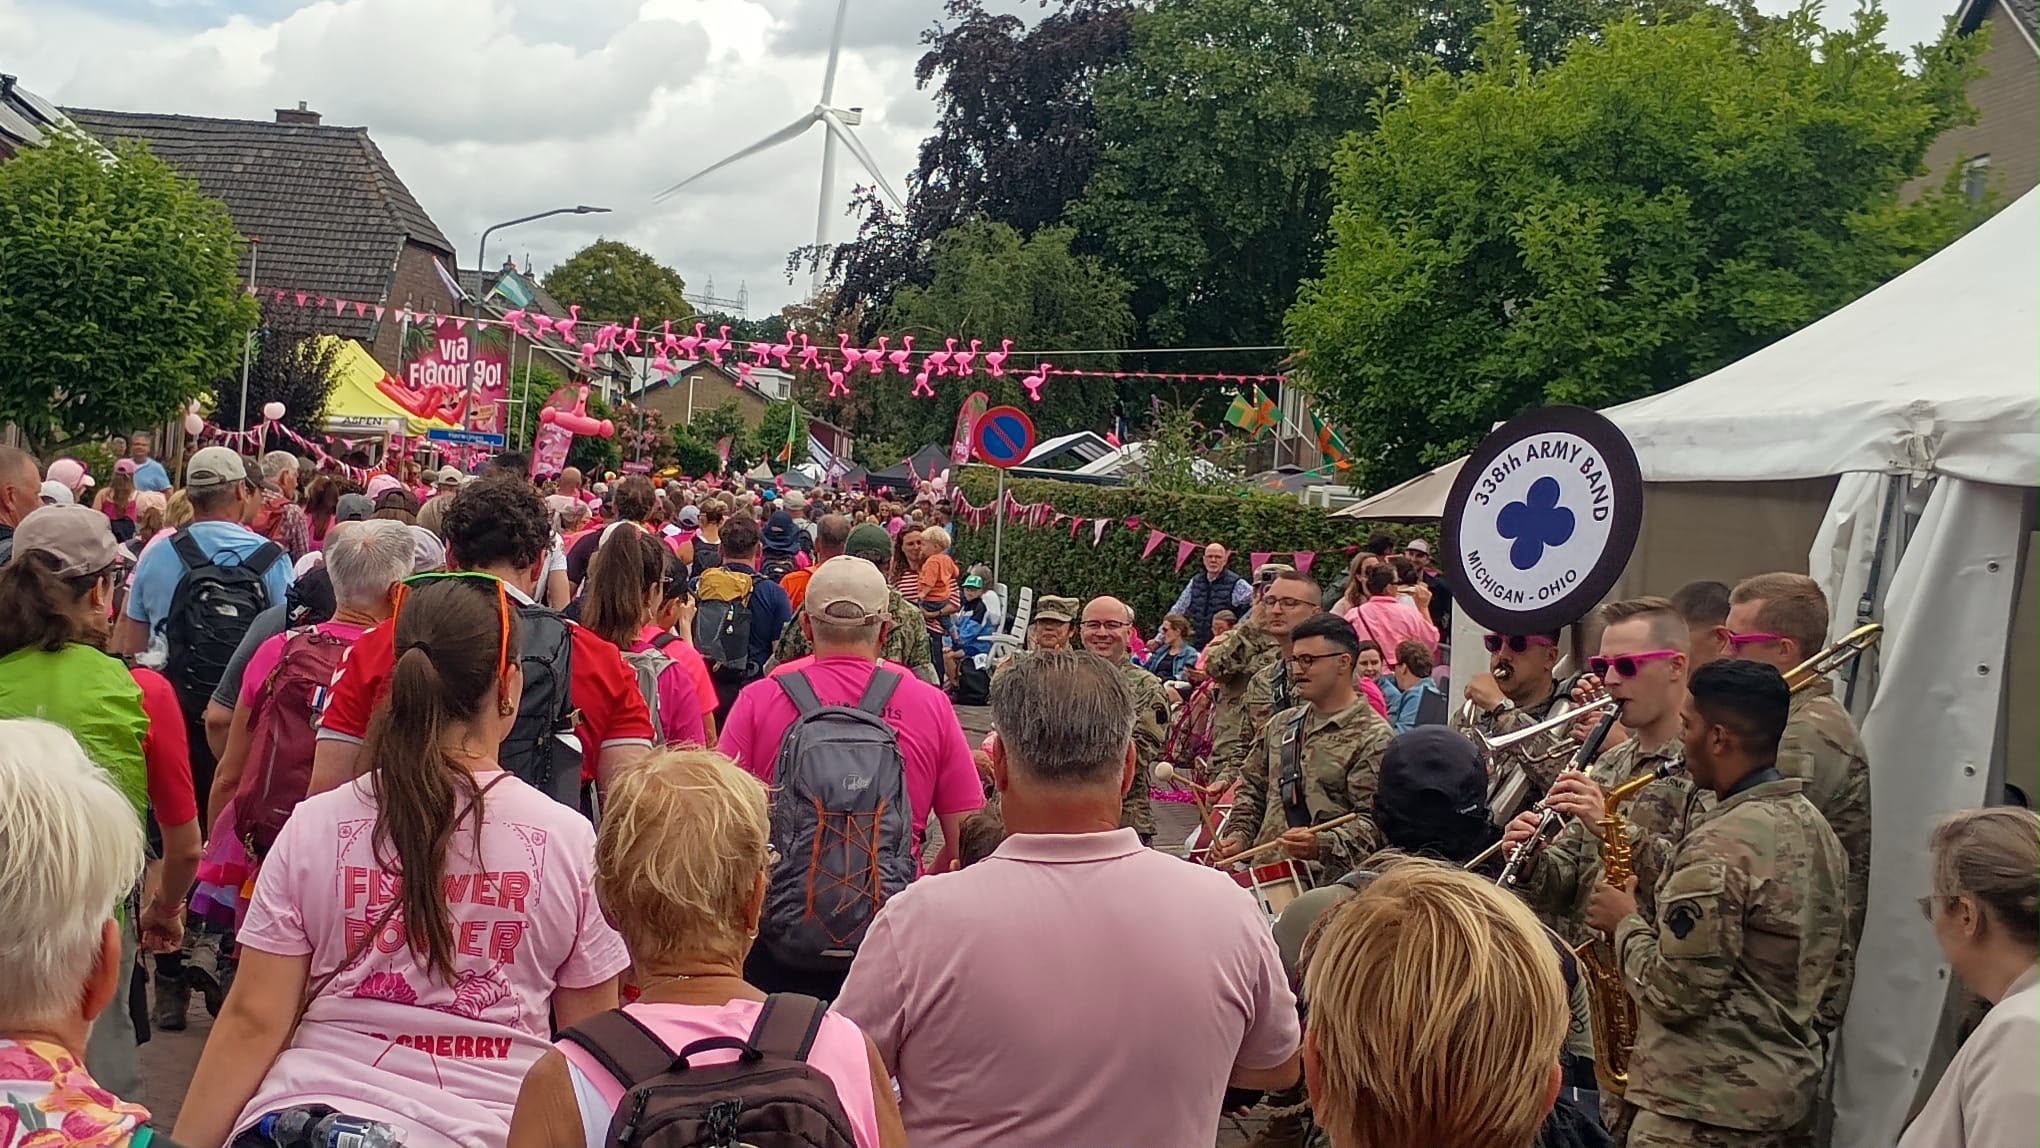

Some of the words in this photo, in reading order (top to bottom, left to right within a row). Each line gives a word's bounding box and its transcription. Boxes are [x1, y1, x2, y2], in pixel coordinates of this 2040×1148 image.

[1475, 453, 1522, 506] 338th
[1526, 440, 1583, 464] ARMY
[1579, 457, 1609, 522] BAND
[1467, 550, 1524, 604] MICHIGAN
[1538, 569, 1577, 601] OHIO
[345, 866, 530, 914] FLWER
[345, 917, 522, 965] POER
